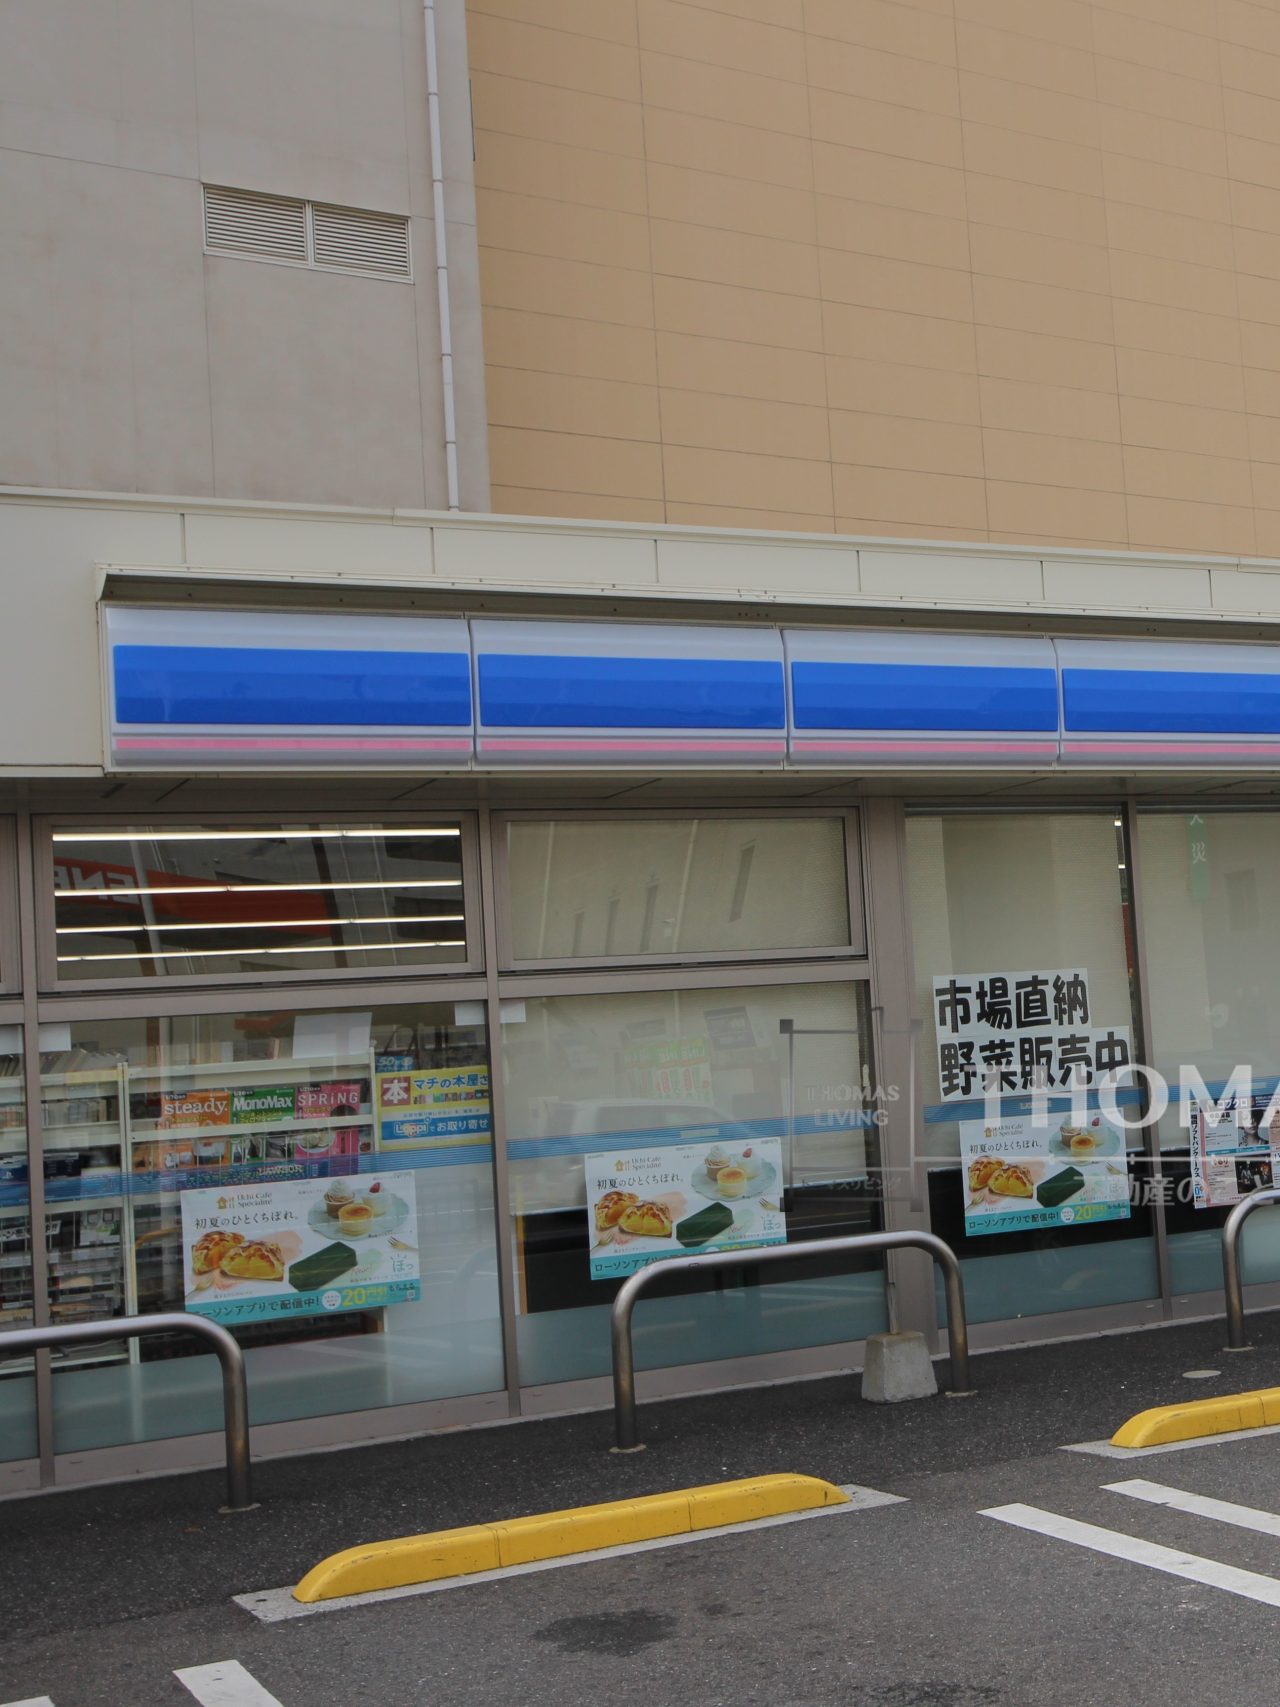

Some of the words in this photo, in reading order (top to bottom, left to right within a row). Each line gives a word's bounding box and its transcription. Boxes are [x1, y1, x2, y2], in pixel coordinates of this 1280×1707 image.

[935, 973, 1089, 1034] 市場直納
[940, 1031, 1130, 1097] 野菜販売中
[232, 1095, 293, 1111] MonoMax
[596, 1174, 684, 1191] 初夏のひとくちぼれ。
[194, 1210, 299, 1230] 初夏のひとくちぼれ。
